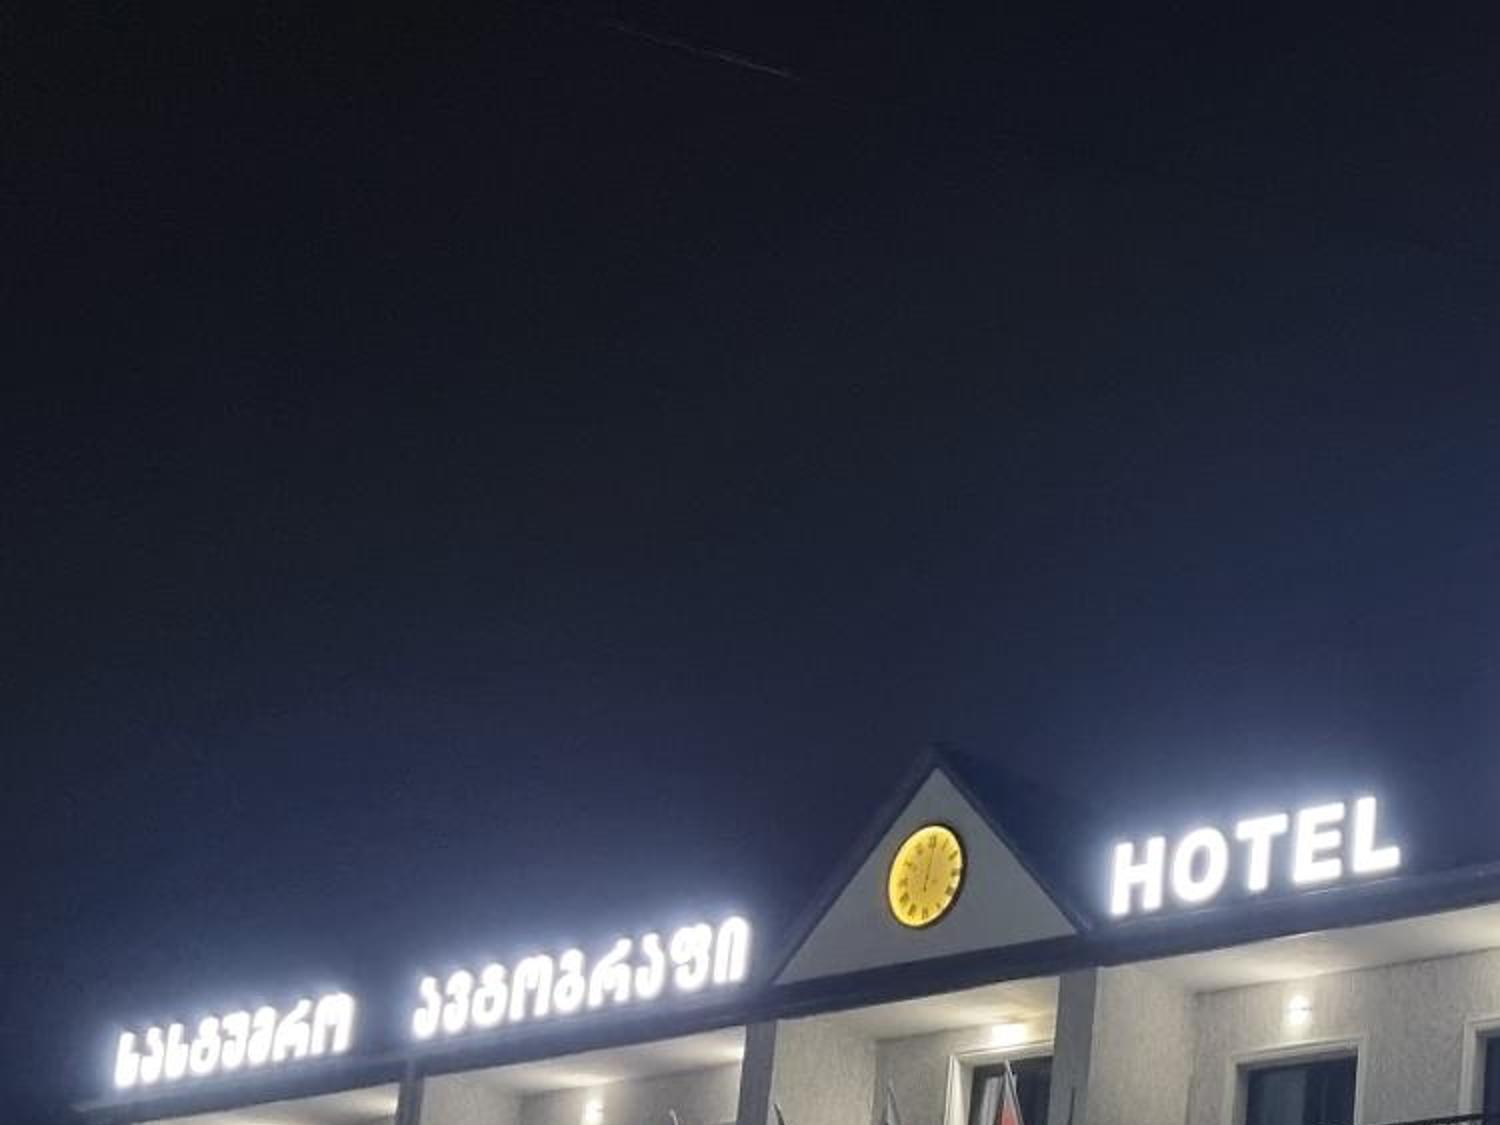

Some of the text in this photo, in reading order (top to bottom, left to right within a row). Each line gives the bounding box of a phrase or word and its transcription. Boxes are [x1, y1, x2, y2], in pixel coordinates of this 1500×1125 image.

[1109, 796, 1401, 916] HOTEL
[113, 916, 749, 1088] სასტუმრო ავტოგრაფი
